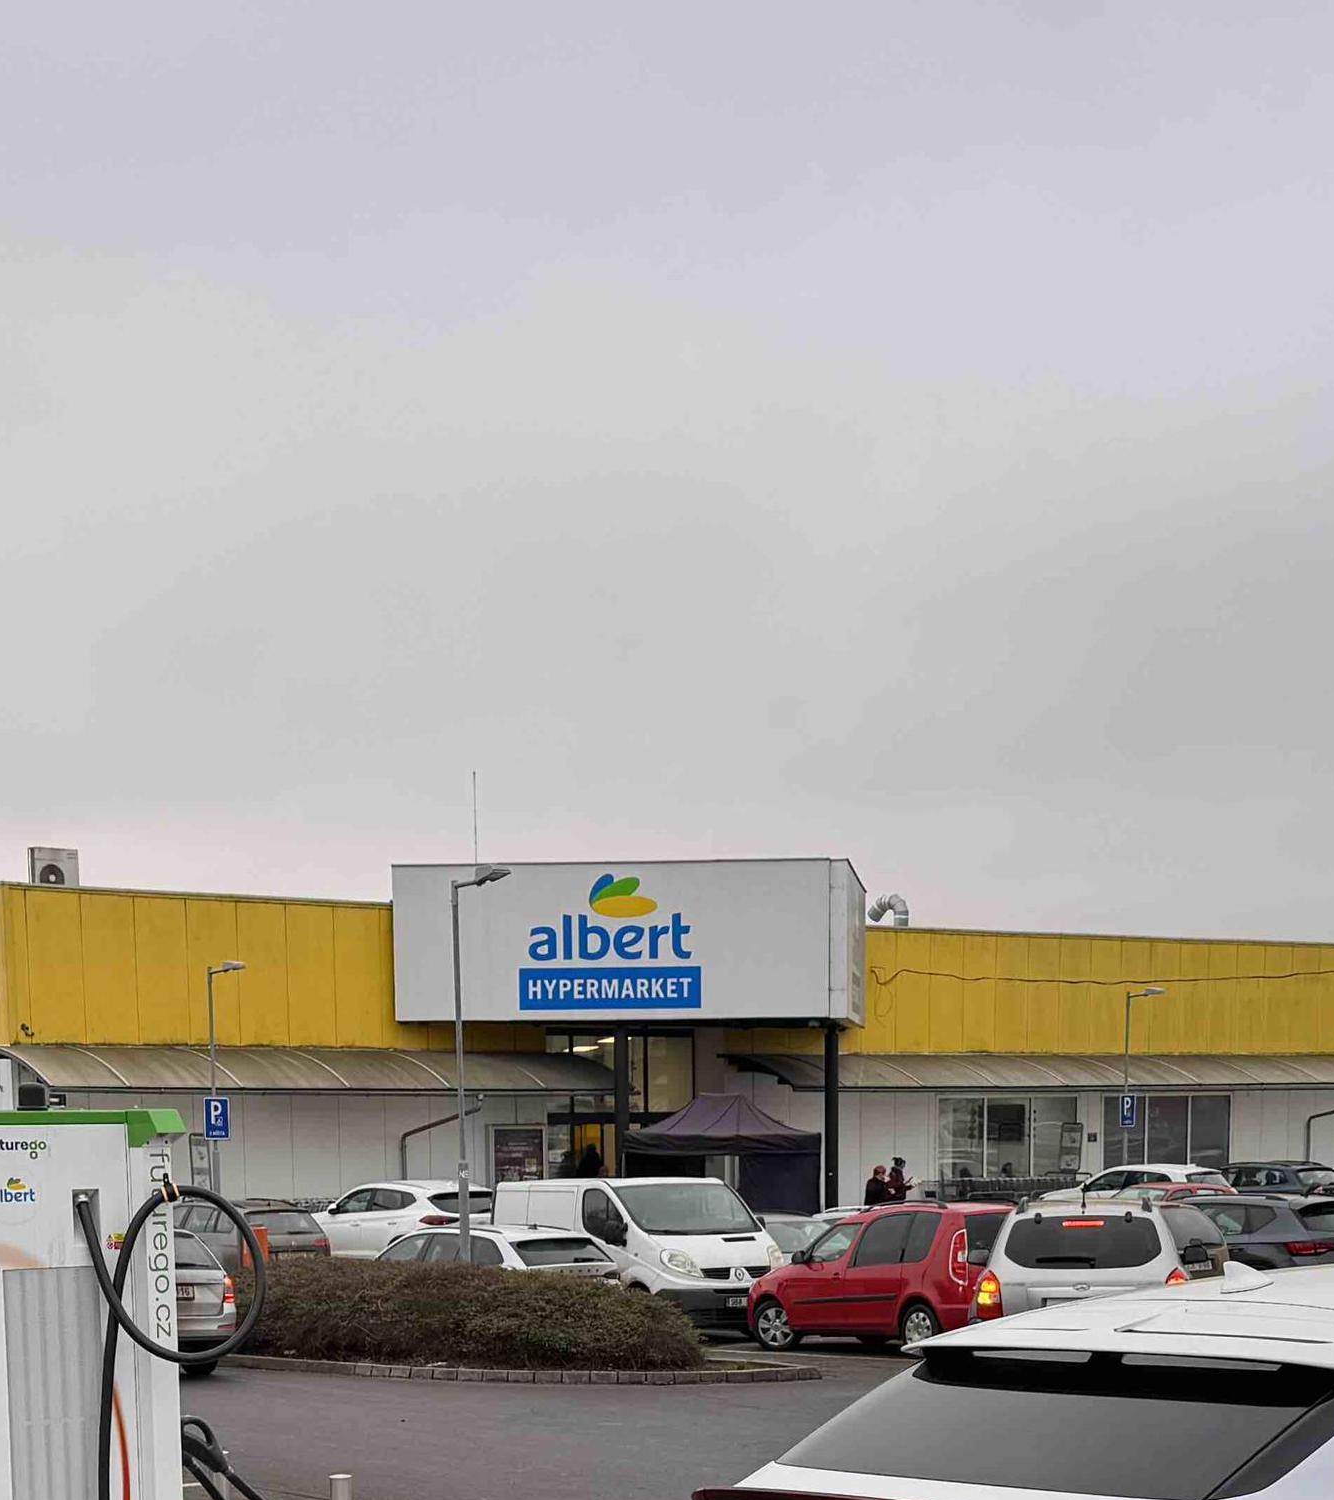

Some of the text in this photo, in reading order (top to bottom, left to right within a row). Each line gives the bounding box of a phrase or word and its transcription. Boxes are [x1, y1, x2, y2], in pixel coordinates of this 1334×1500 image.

[528, 912, 692, 961] albert
[528, 977, 692, 1000] HYPERMARKET
[210, 1101, 223, 1125] P
